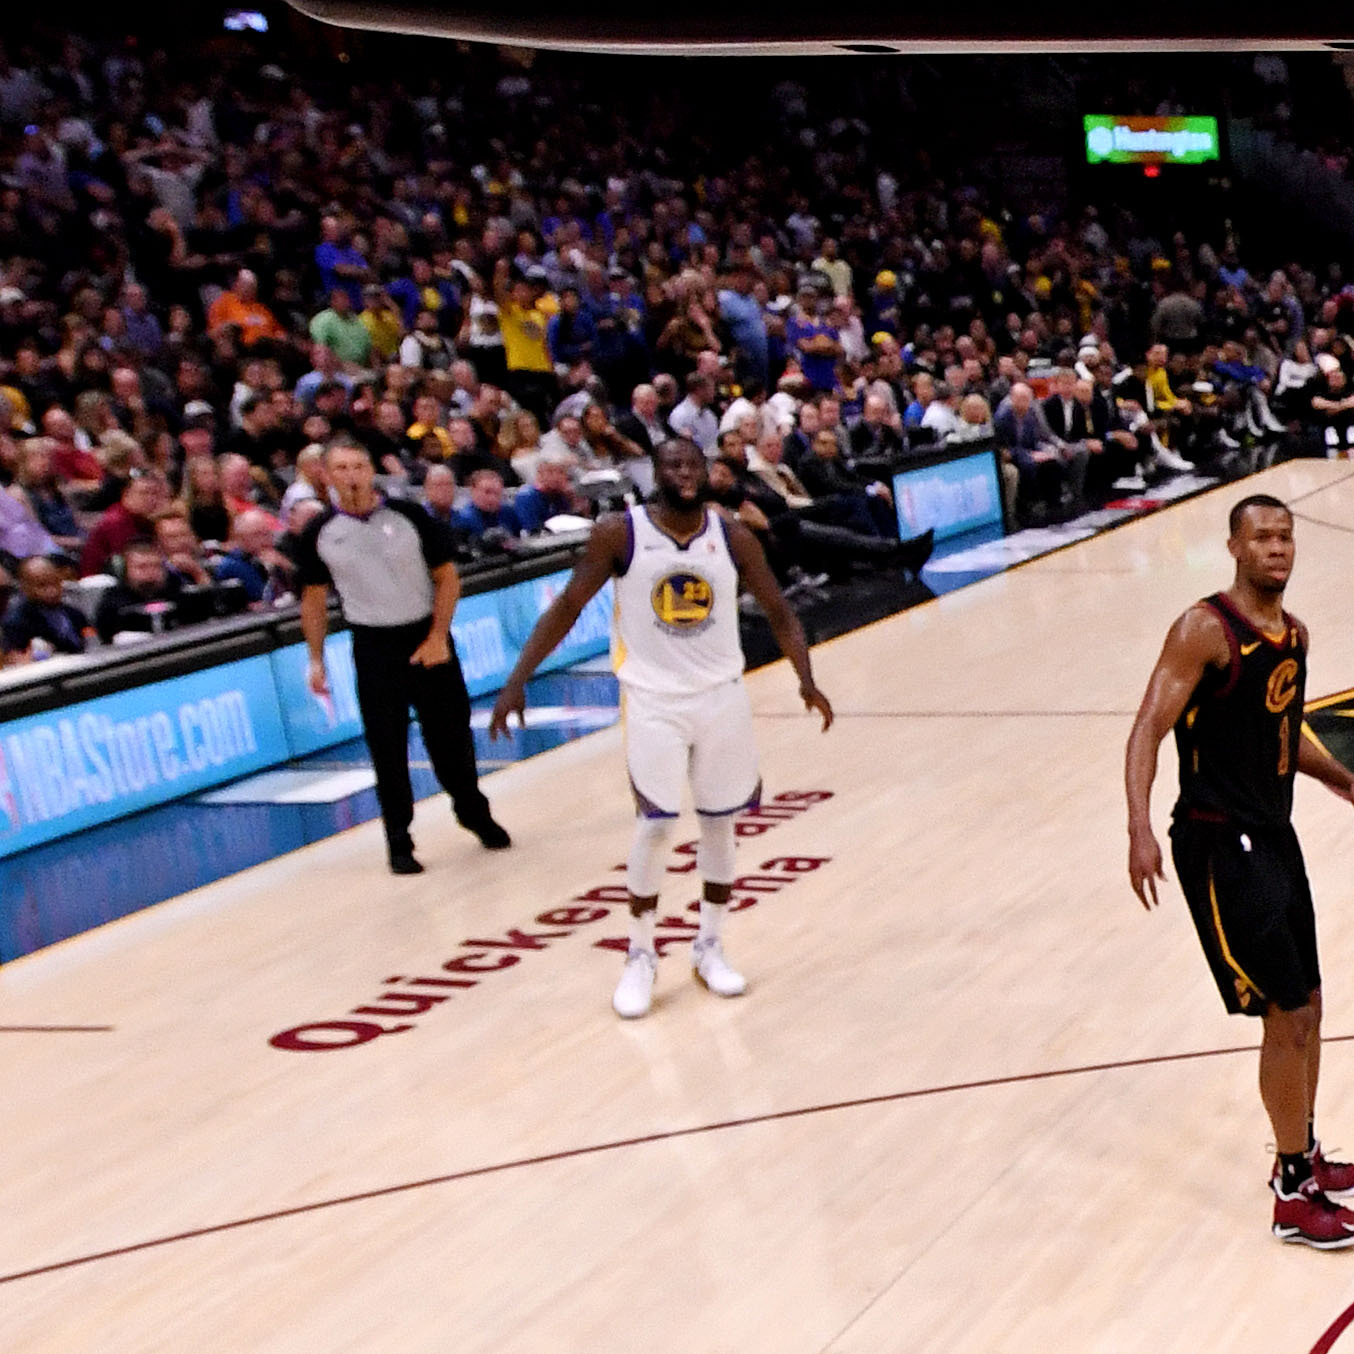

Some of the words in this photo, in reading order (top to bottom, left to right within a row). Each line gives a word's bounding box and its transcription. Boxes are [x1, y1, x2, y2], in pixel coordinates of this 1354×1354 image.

[1266, 658, 1298, 713] C
[6, 690, 258, 824] NBAStore.com
[1277, 716, 1290, 776] 1
[268, 886, 628, 1051] Quicken
